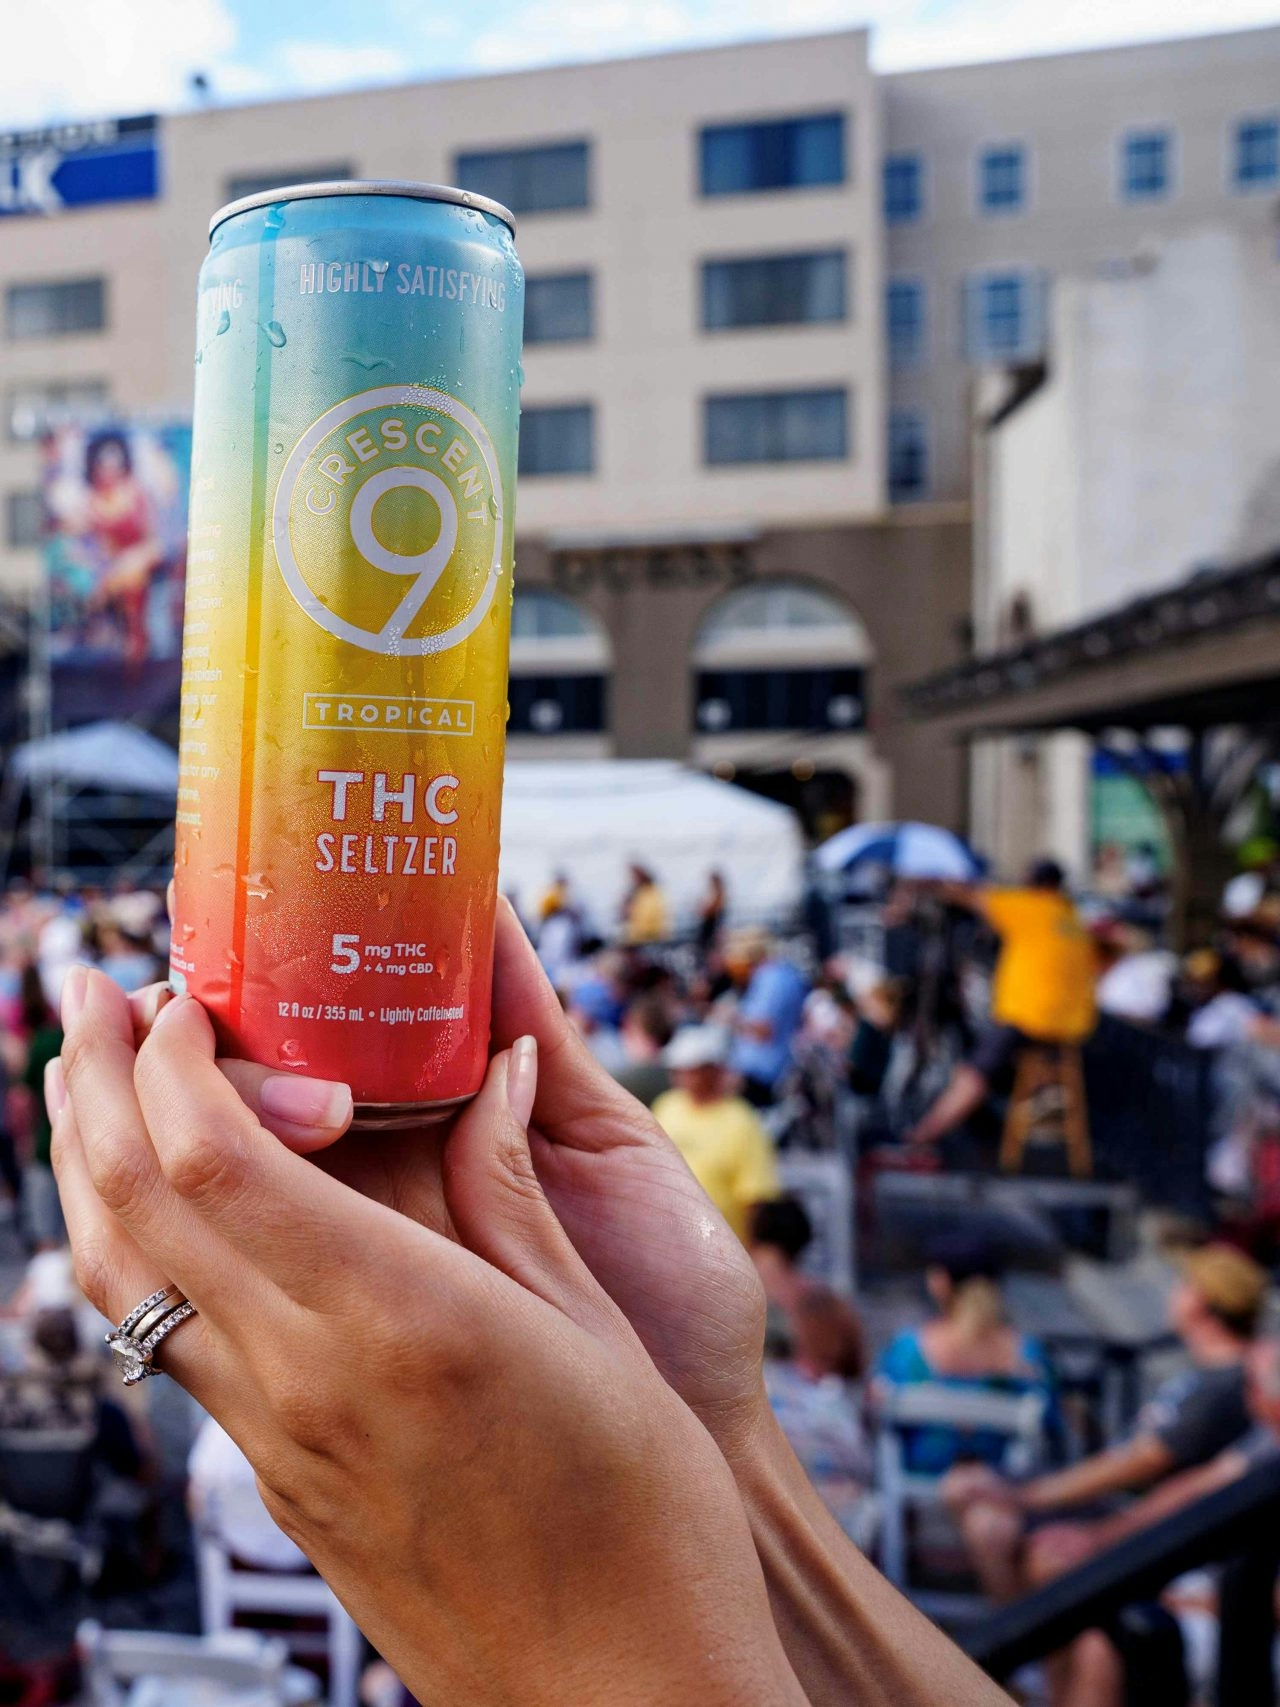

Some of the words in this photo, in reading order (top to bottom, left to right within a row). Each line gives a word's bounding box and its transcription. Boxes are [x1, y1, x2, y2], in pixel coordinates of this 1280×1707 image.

[299, 261, 388, 295] HIGHLY
[396, 263, 506, 312] SATISFYING
[306, 419, 488, 526] CRESCENT
[349, 465, 459, 640] 9
[314, 702, 467, 728] TROPICAL
[317, 770, 461, 826] THC
[315, 832, 458, 876] SELTZER
[330, 933, 361, 975] 5
[364, 945, 392, 960] mg
[394, 943, 427, 957] THC
[374, 962, 384, 974] 4
[385, 964, 406, 976] mg
[408, 962, 434, 974] CBD
[278, 1002, 289, 1017] 12
[291, 1002, 299, 1017] fl
[301, 1006, 314, 1019] oz
[324, 1005, 347, 1021] 355
[348, 1006, 365, 1022] mL
[379, 1007, 416, 1026] Lightly
